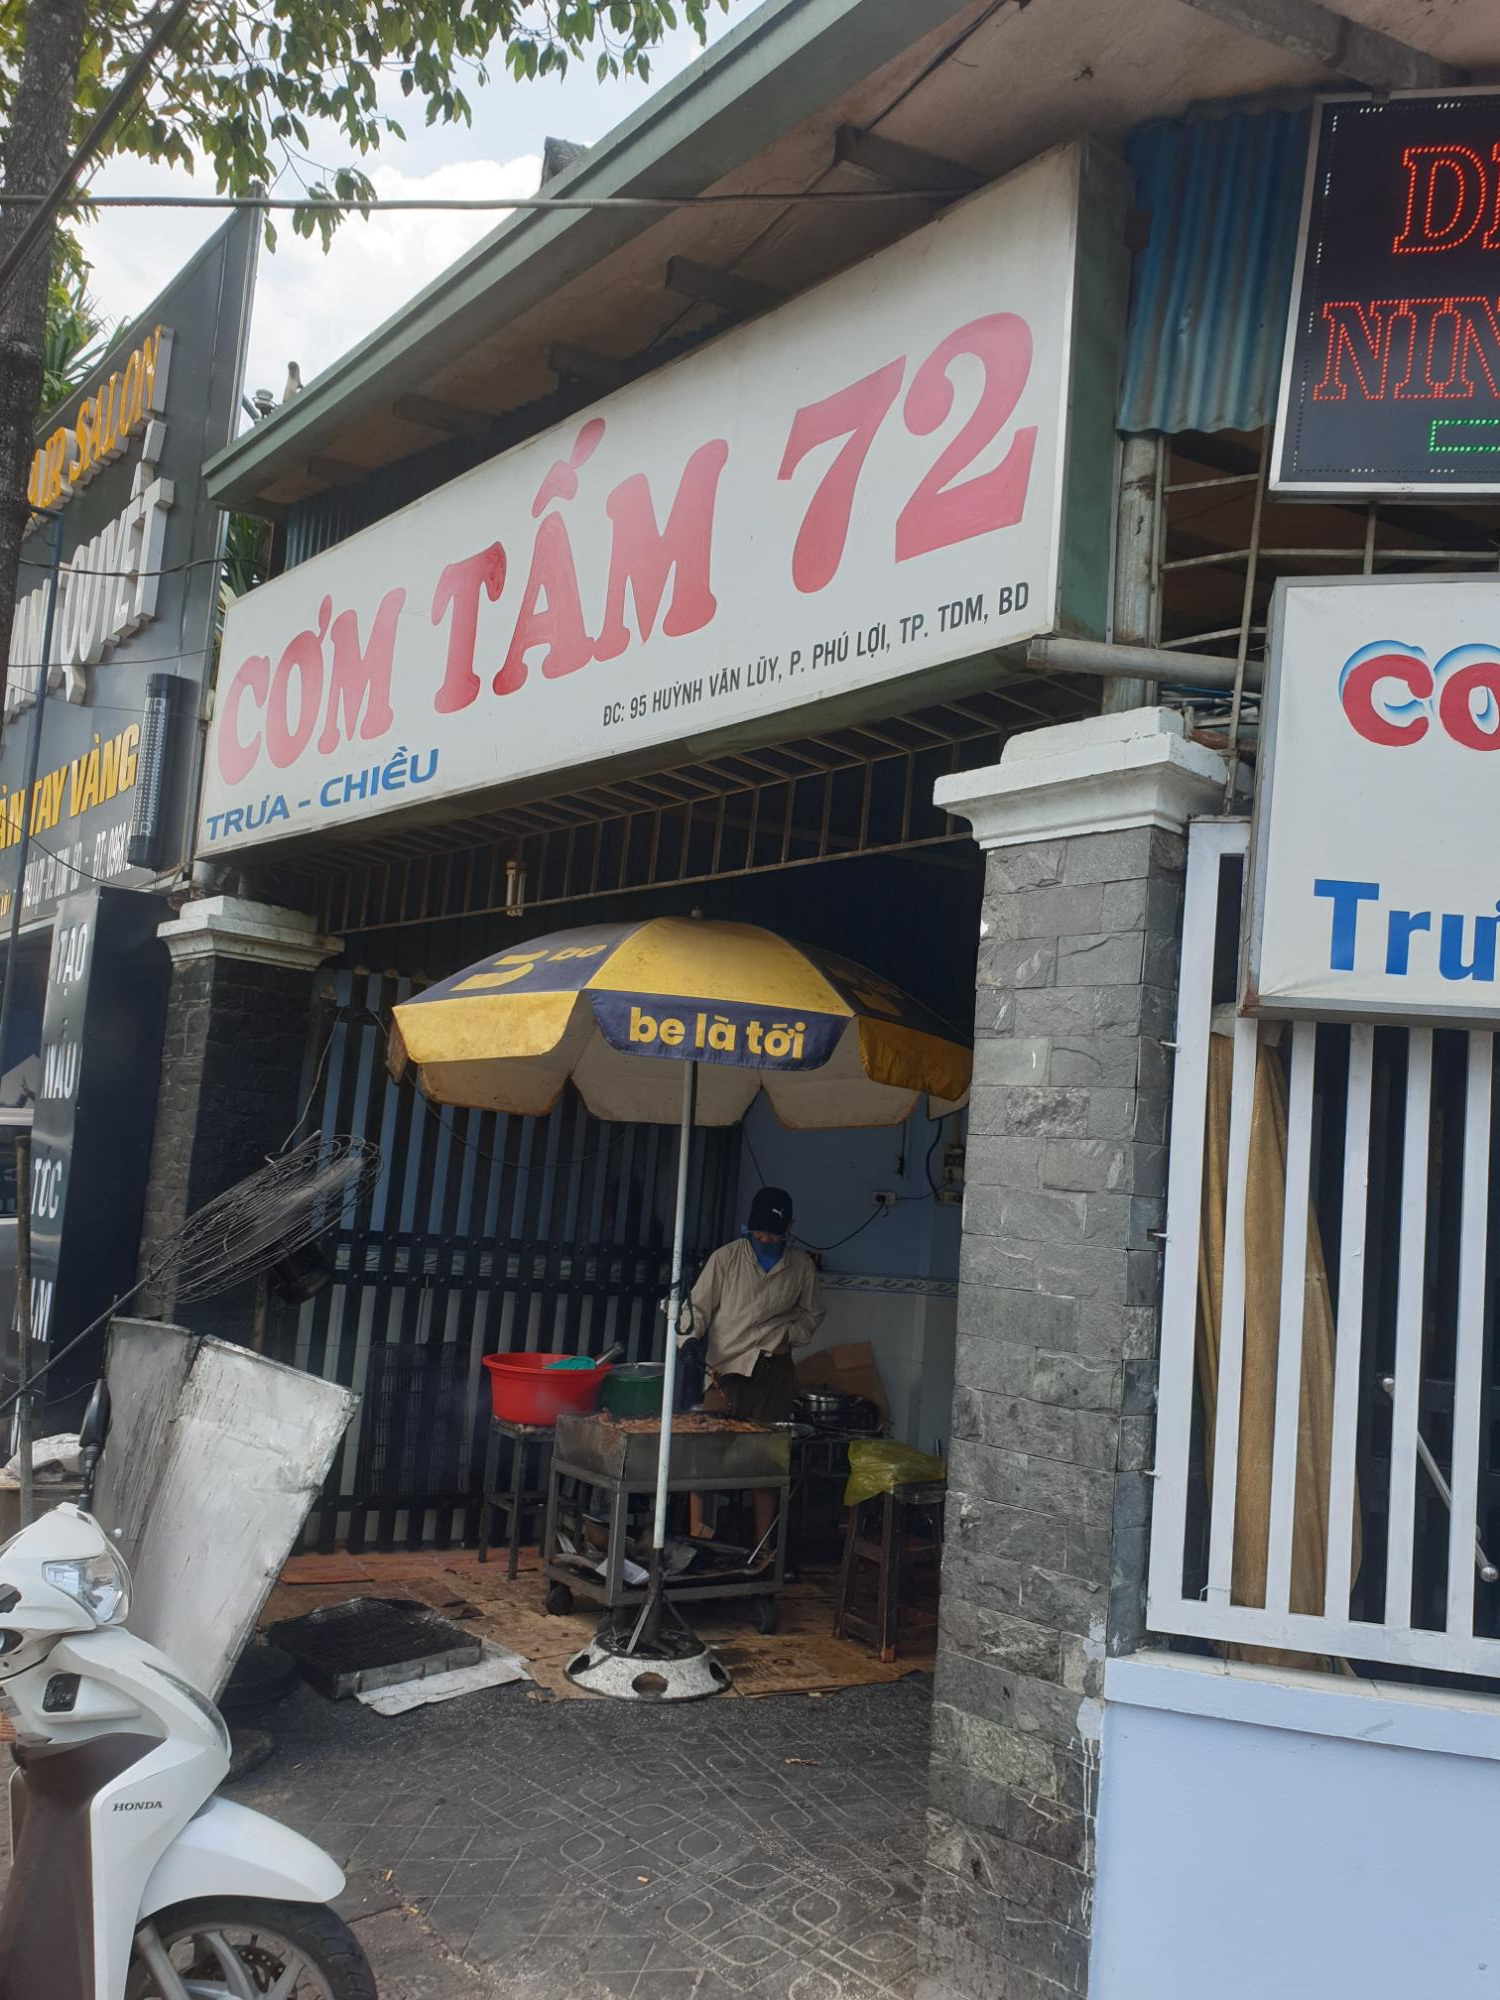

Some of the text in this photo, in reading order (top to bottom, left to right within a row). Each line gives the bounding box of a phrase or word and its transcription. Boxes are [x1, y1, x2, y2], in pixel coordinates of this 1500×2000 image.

[1392, 141, 1500, 254] D
[68, 322, 173, 486] SALON
[217, 311, 1039, 787] CƠM TẤM 72
[603, 581, 1030, 727] ĐC: 95 HUỲNH VĂN LŨY, P. PHÚ LỢI, TP. TDM, BD
[69, 723, 141, 818] VÀNG
[206, 792, 291, 842] TRƯA
[318, 745, 440, 809] CHIỀU
[628, 1006, 807, 1060] be là tới
[112, 1800, 163, 1812] HONDA
